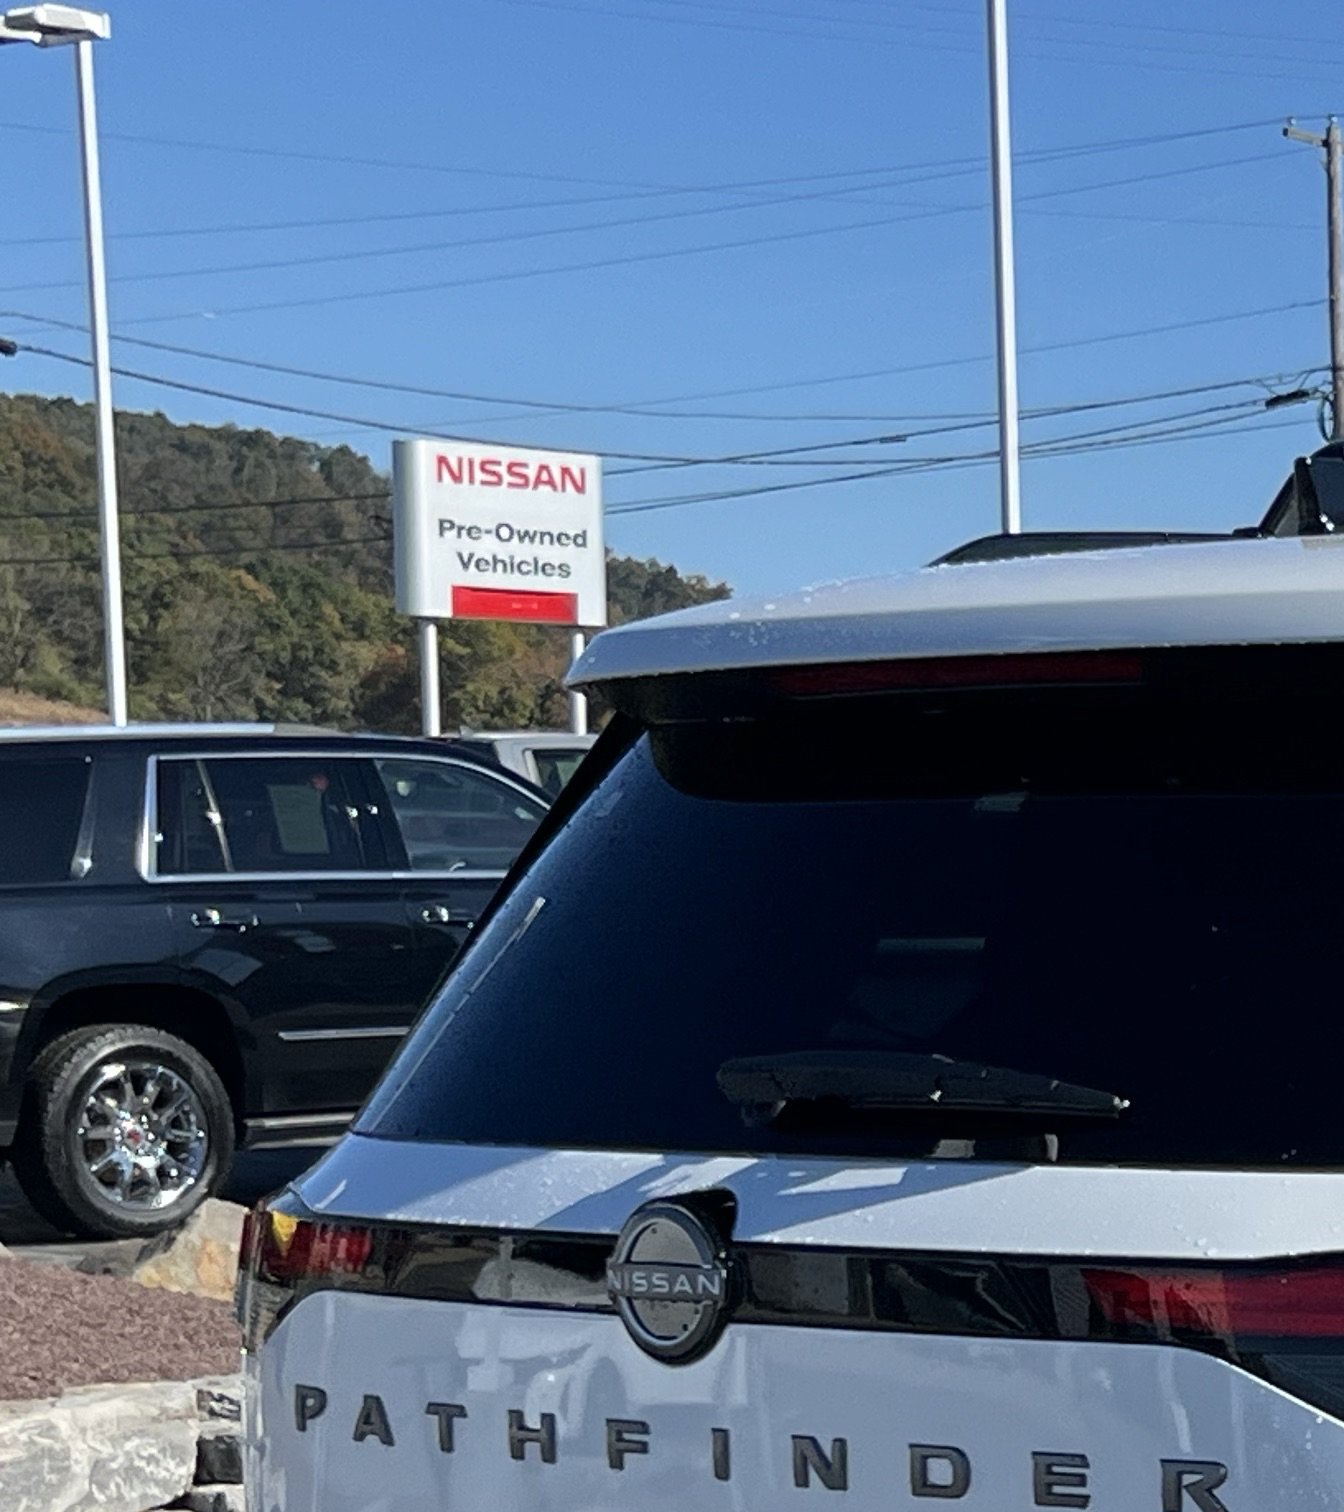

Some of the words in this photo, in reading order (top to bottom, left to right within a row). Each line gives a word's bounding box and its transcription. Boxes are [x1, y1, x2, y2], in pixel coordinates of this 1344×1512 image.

[436, 454, 587, 495] NISSAN
[438, 518, 588, 548] Pre-Owned
[457, 551, 572, 579] Vehicles
[607, 1269, 721, 1296] NISSAN
